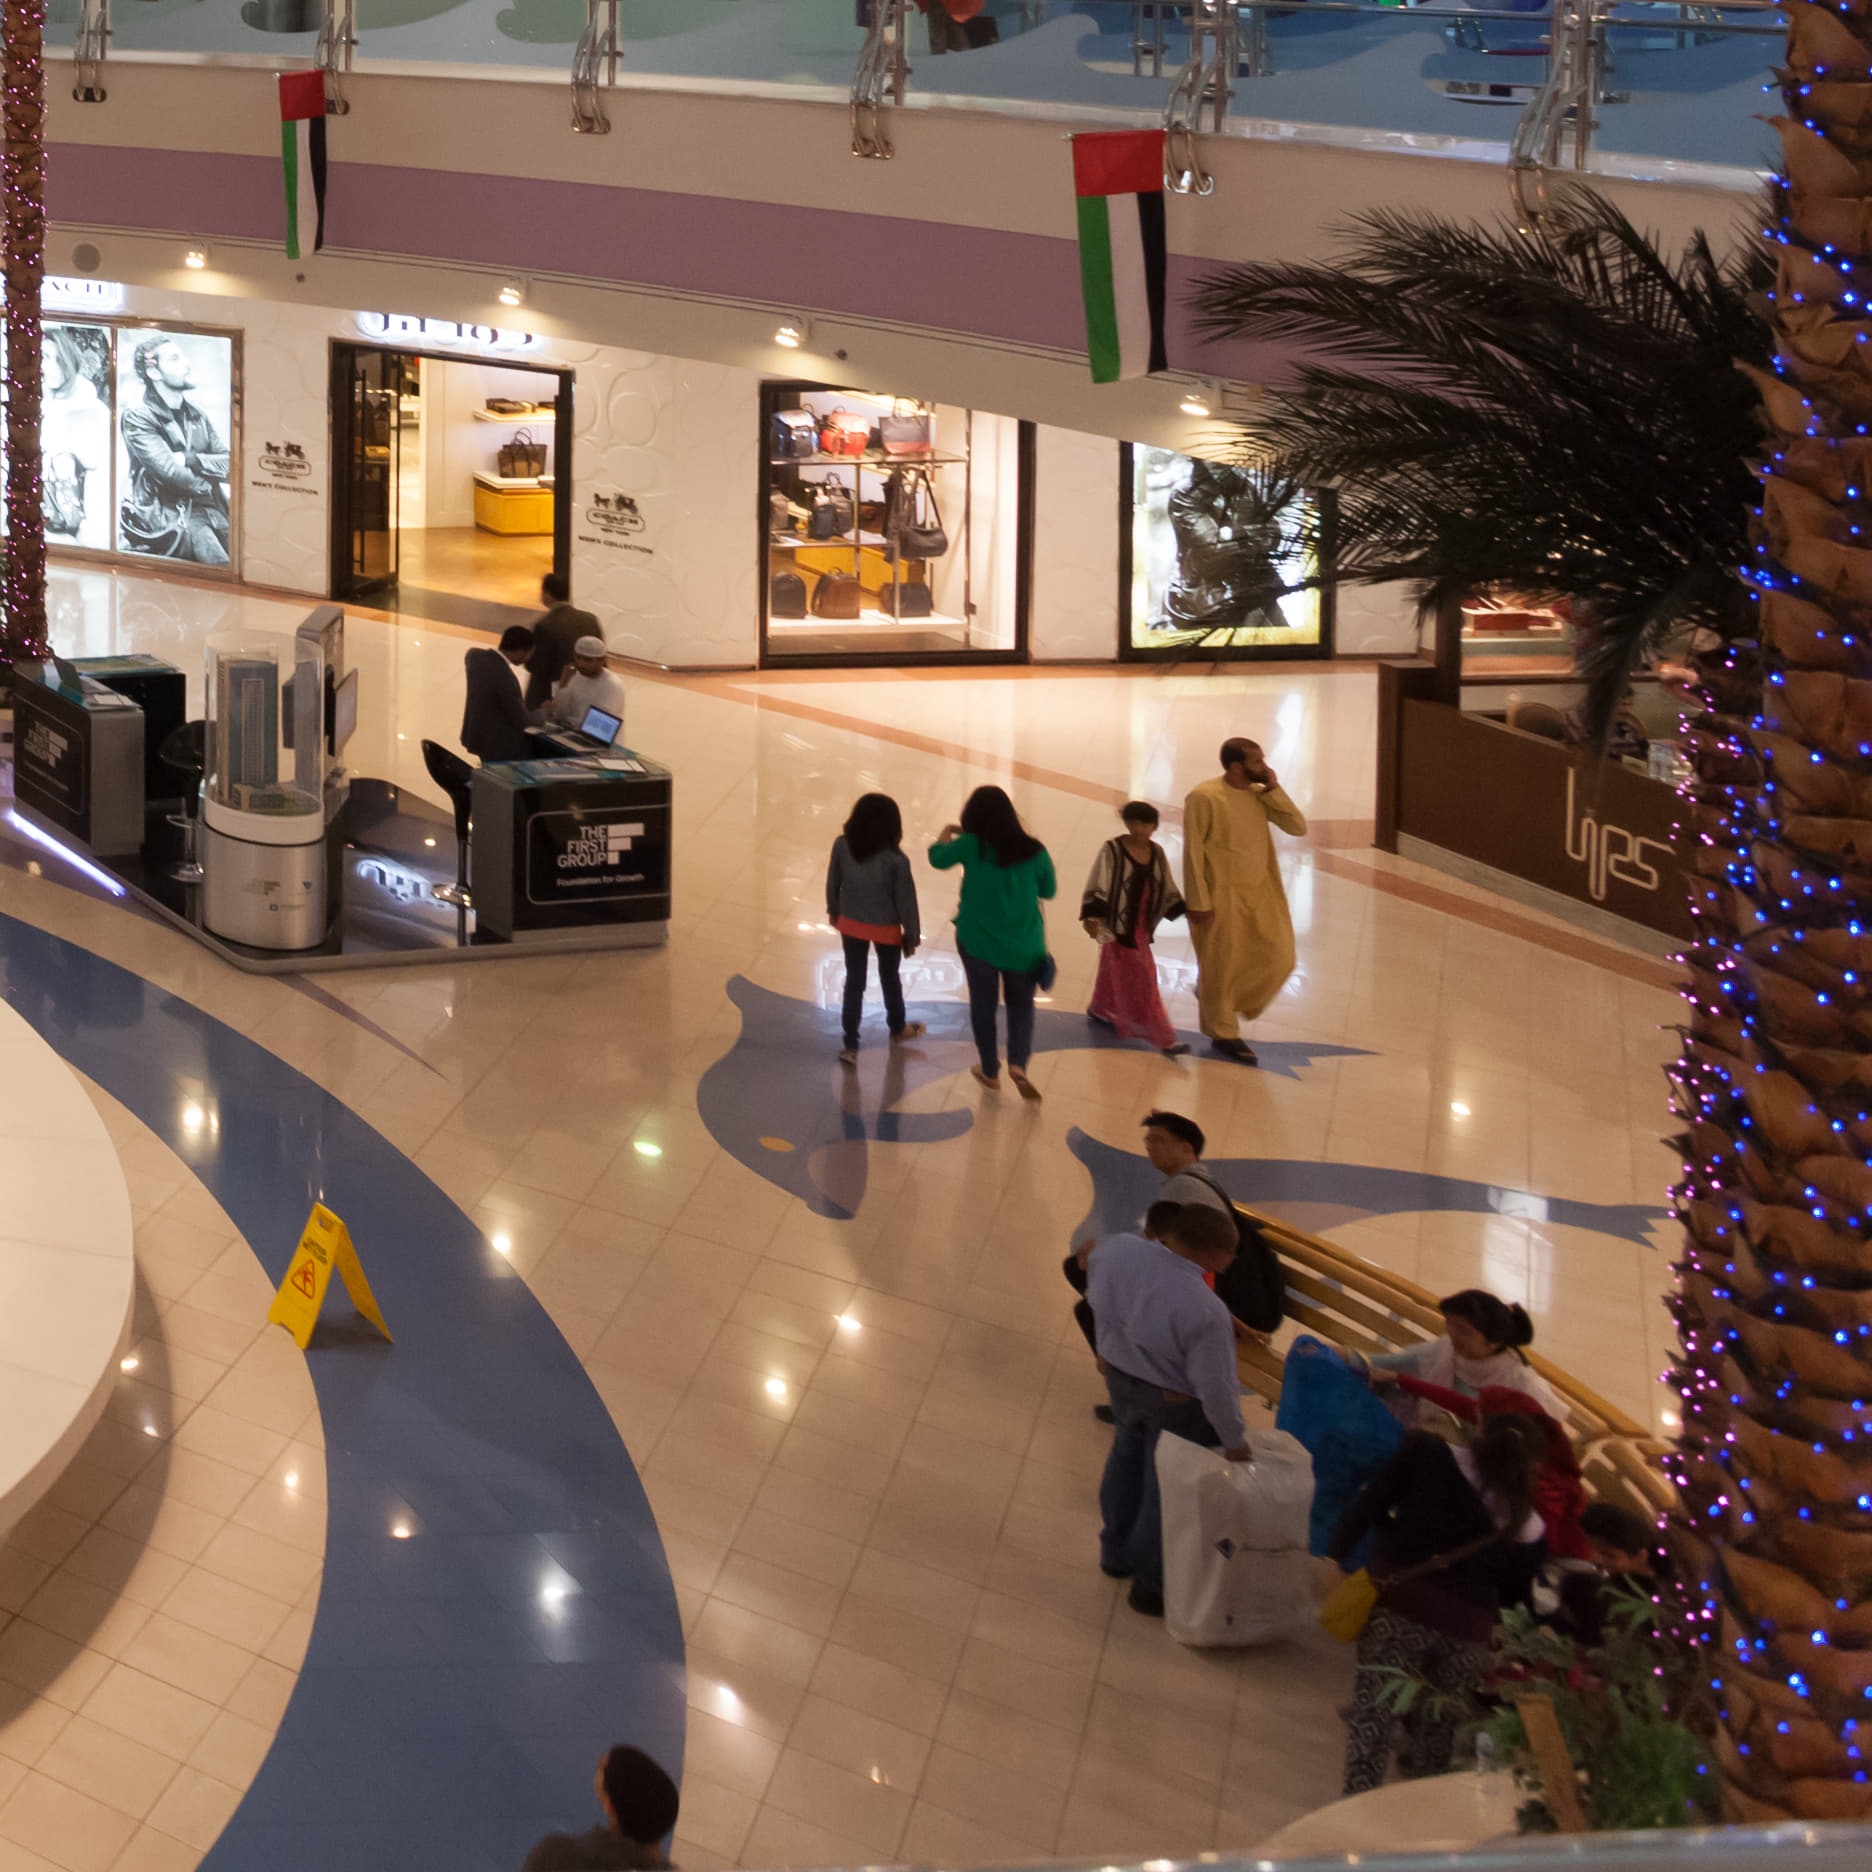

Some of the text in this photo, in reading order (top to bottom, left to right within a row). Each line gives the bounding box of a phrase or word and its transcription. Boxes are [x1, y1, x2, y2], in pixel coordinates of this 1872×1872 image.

[579, 825, 608, 840] THE
[567, 839, 607, 854] FIRST
[557, 852, 608, 868] GROUP
